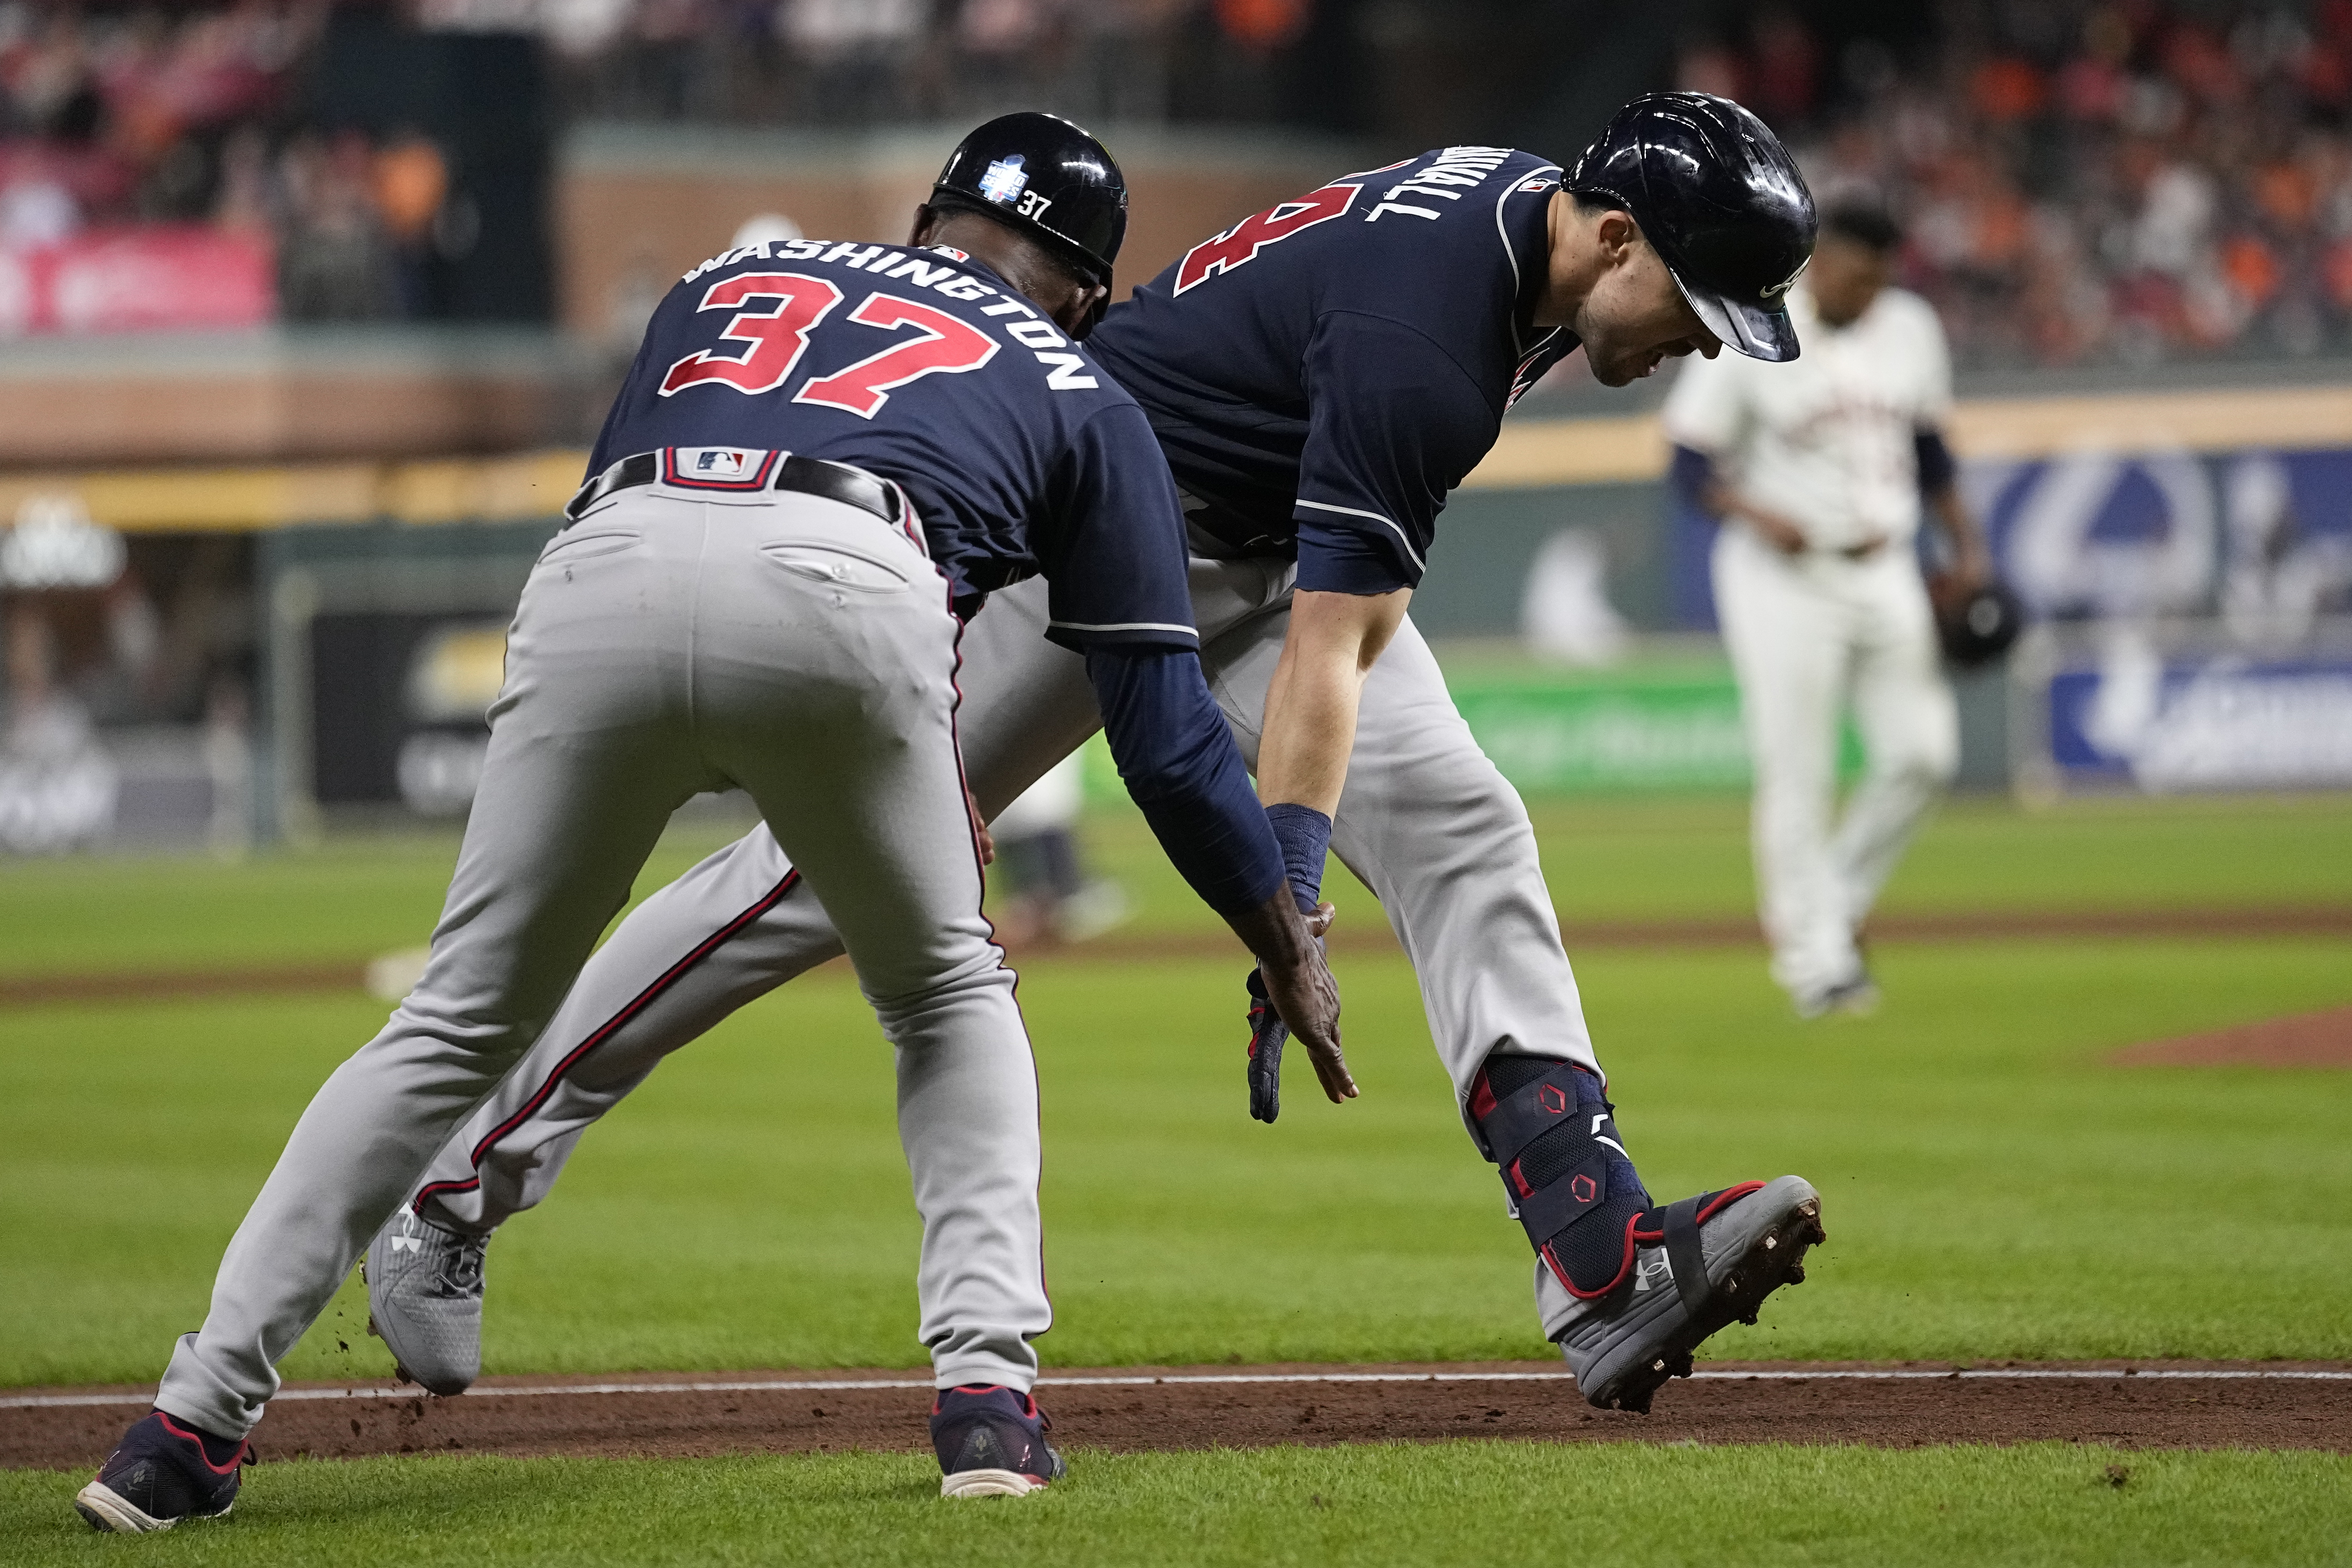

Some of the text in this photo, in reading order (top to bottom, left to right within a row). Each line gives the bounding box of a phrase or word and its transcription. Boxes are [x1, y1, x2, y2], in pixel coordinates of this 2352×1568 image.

[981, 175, 1020, 197] SEES
[987, 166, 1025, 187] WOD
[1017, 189, 1052, 221] 37
[1174, 158, 1418, 298] 4
[658, 271, 1002, 420] 37
[682, 239, 1099, 390] WASHINGTON
